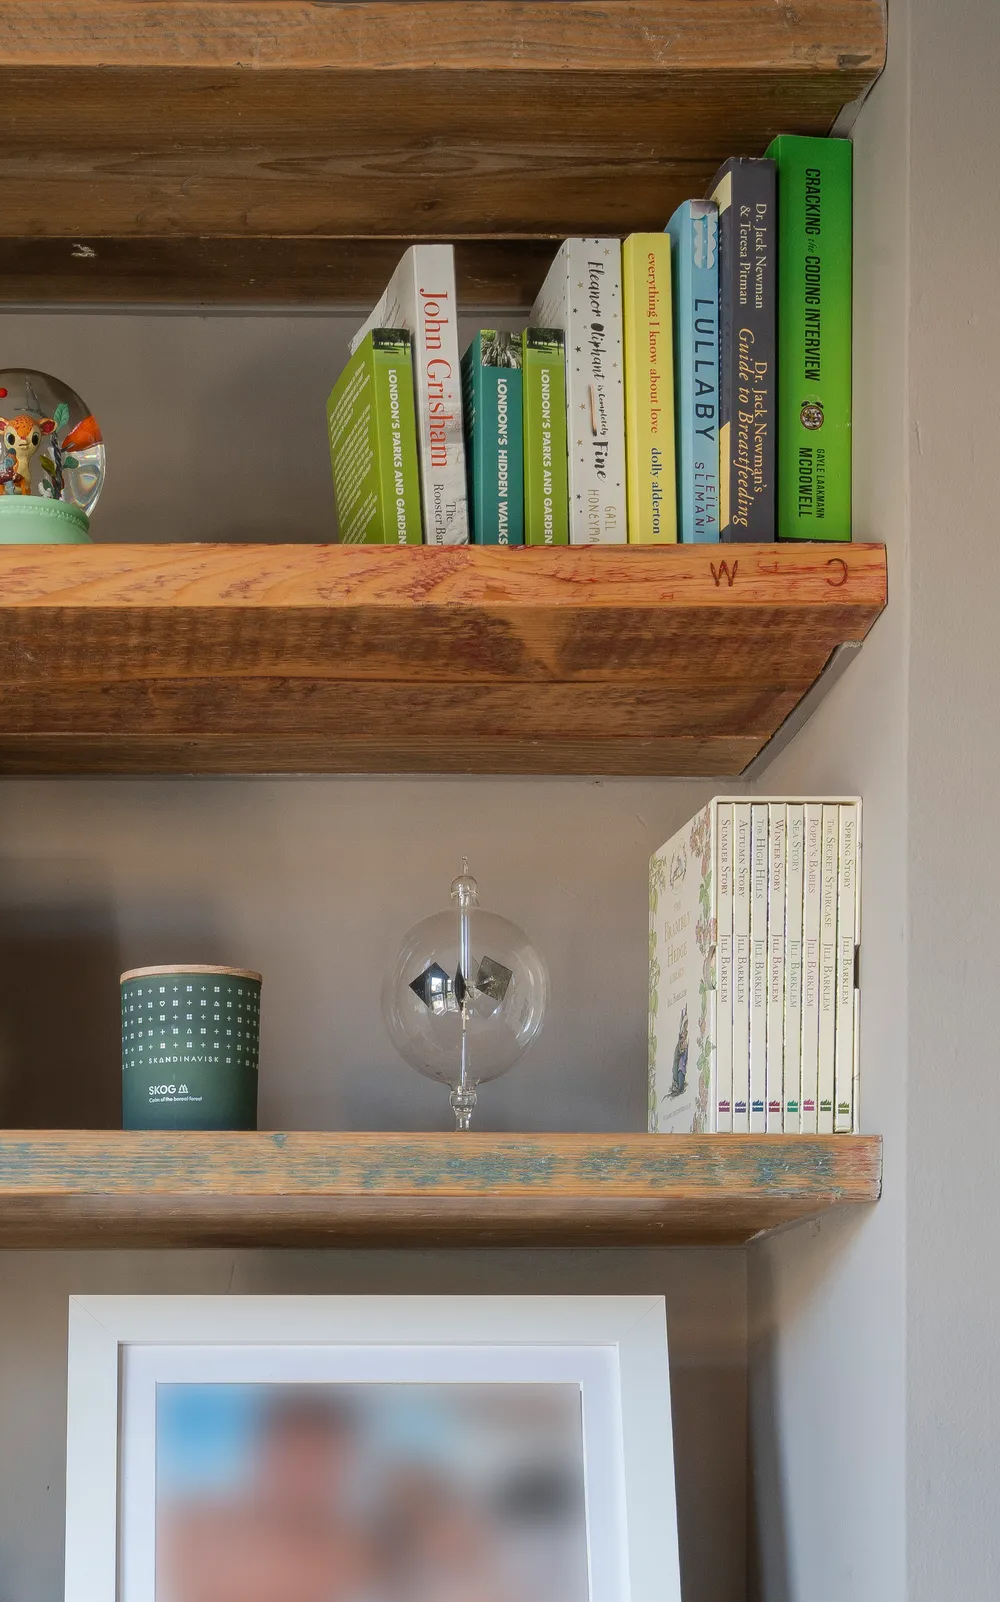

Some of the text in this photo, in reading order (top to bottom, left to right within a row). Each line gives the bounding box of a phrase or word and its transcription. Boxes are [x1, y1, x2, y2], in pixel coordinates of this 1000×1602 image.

[587, 261, 604, 317] Eleanor
[647, 252, 660, 317] everything
[739, 205, 750, 305] & Teresa Pitman
[755, 203, 767, 309] Dr. Jack Newman
[804, 168, 821, 382] CRACKING the CODING INTERVIEW
[419, 288, 454, 467] John Grisham
[588, 322, 607, 380] Oliphant
[649, 328, 661, 364] know
[694, 299, 715, 442] LULLABY
[650, 368, 661, 402] about
[388, 369, 404, 496] LONDON'S PARKS AND
[540, 369, 552, 496] LONDON'S PARKS AND
[650, 406, 662, 434] love
[732, 327, 755, 528] Guide to Breastfeeding
[752, 361, 768, 494] Dr. Jack Newman's
[497, 378, 508, 544] LONDON'S HIDDEN WALKS
[592, 440, 609, 484] Fine
[650, 447, 664, 478] dolly
[798, 447, 812, 518] MCDOWELL
[816, 448, 825, 518] GAYLE LAAKMANN
[433, 484, 443, 526] Rooster
[445, 501, 457, 523] The
[604, 505, 616, 532] GAIL
[651, 482, 662, 534] alderton
[694, 462, 705, 534] SLIMANI
[705, 474, 718, 524] LEÏLA
[720, 820, 731, 896] SUMMER STORY
[738, 820, 748, 898] AUTUMN STORY
[756, 838, 766, 899] HIGH HILLS
[773, 820, 784, 892] WINTER STORY
[792, 820, 802, 872] SEA STORY
[808, 819, 819, 894] POPPY'S BABIES
[844, 822, 854, 889] SPRING STORY
[824, 837, 836, 928] SECRET STAIRCASE
[720, 934, 730, 1002] JILL BARKLEM
[736, 934, 747, 1002] JILL BARKLEM
[754, 940, 764, 1008] JILL BARKLEM
[772, 934, 782, 1002] JILL BARKLEM
[790, 940, 800, 1008] JILL BARKLEM
[806, 938, 816, 1006] JILL BARKLEM
[822, 944, 833, 1012] JILL BARKLEM
[842, 936, 852, 1004] JILL BARKLEM
[148, 1084, 176, 1095] SKOG
